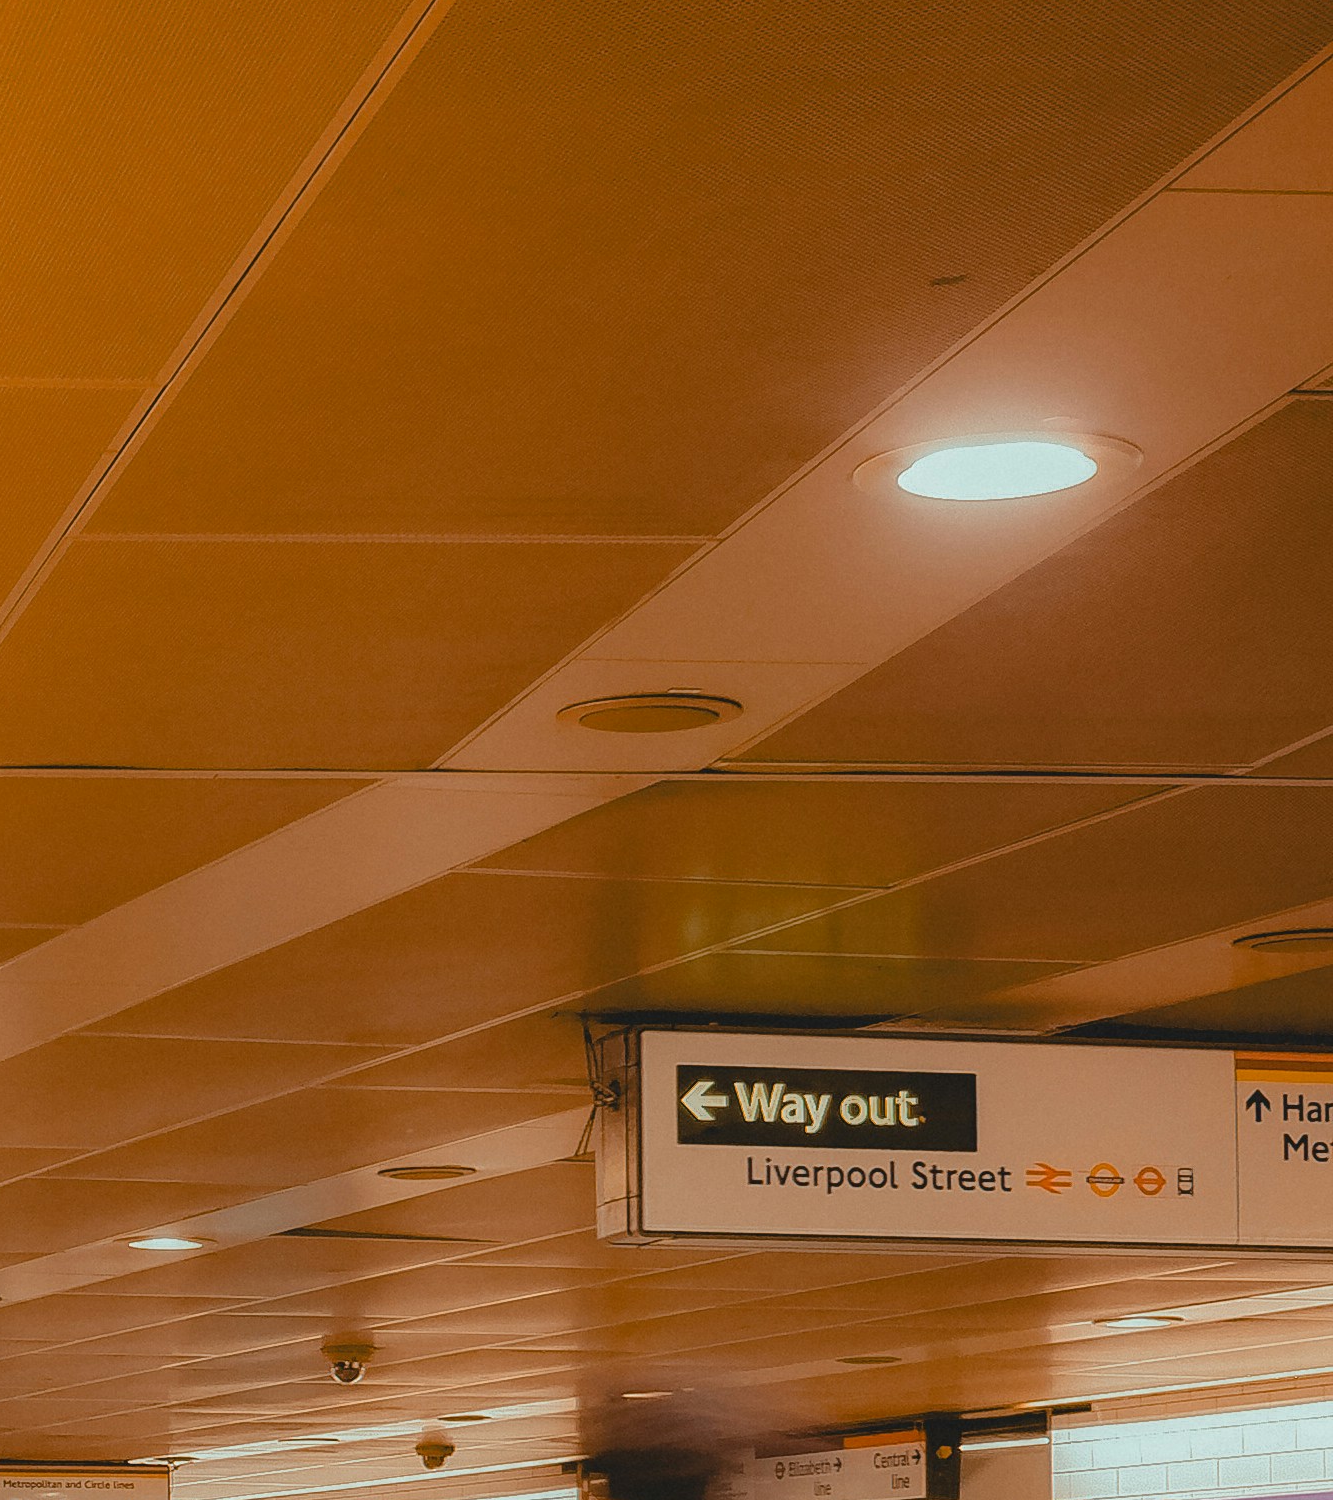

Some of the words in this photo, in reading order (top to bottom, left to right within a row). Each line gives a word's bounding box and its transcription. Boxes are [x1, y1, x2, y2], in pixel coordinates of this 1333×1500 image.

[734, 1082, 832, 1134] Way
[840, 1090, 919, 1127] out
[1283, 1133, 1333, 1162] Me
[747, 1156, 898, 1194] Liverpool
[911, 1161, 1012, 1192] Street
[873, 1451, 910, 1469] Central
[3, 1479, 62, 1490] Metropolitan
[65, 1480, 82, 1489] and
[84, 1480, 110, 1490] Circle
[113, 1480, 134, 1490] lines
[891, 1474, 910, 1490] line
